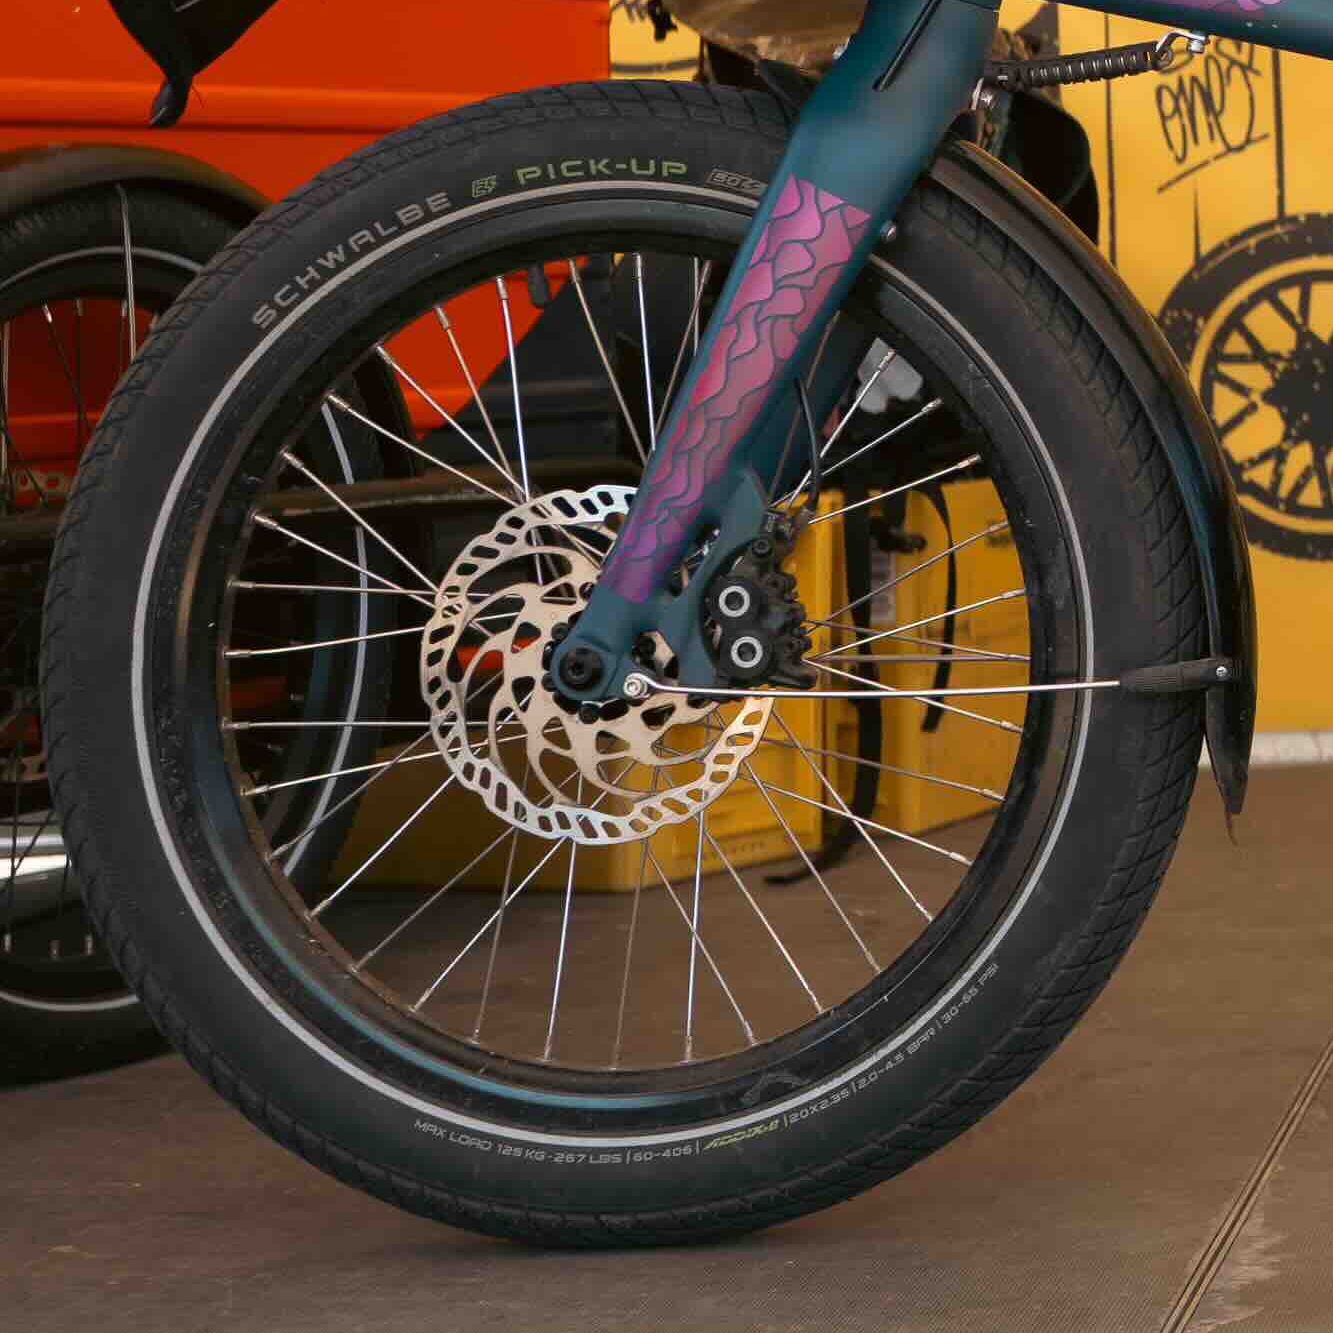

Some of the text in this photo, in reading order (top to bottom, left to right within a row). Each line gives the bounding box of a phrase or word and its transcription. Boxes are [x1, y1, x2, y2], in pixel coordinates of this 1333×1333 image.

[252, 191, 452, 329] SCHWALBE
[514, 157, 689, 185] PICK-UP
[413, 1119, 448, 1139] MAX
[449, 1132, 493, 1152] LOAD
[588, 1152, 624, 1165] LBS
